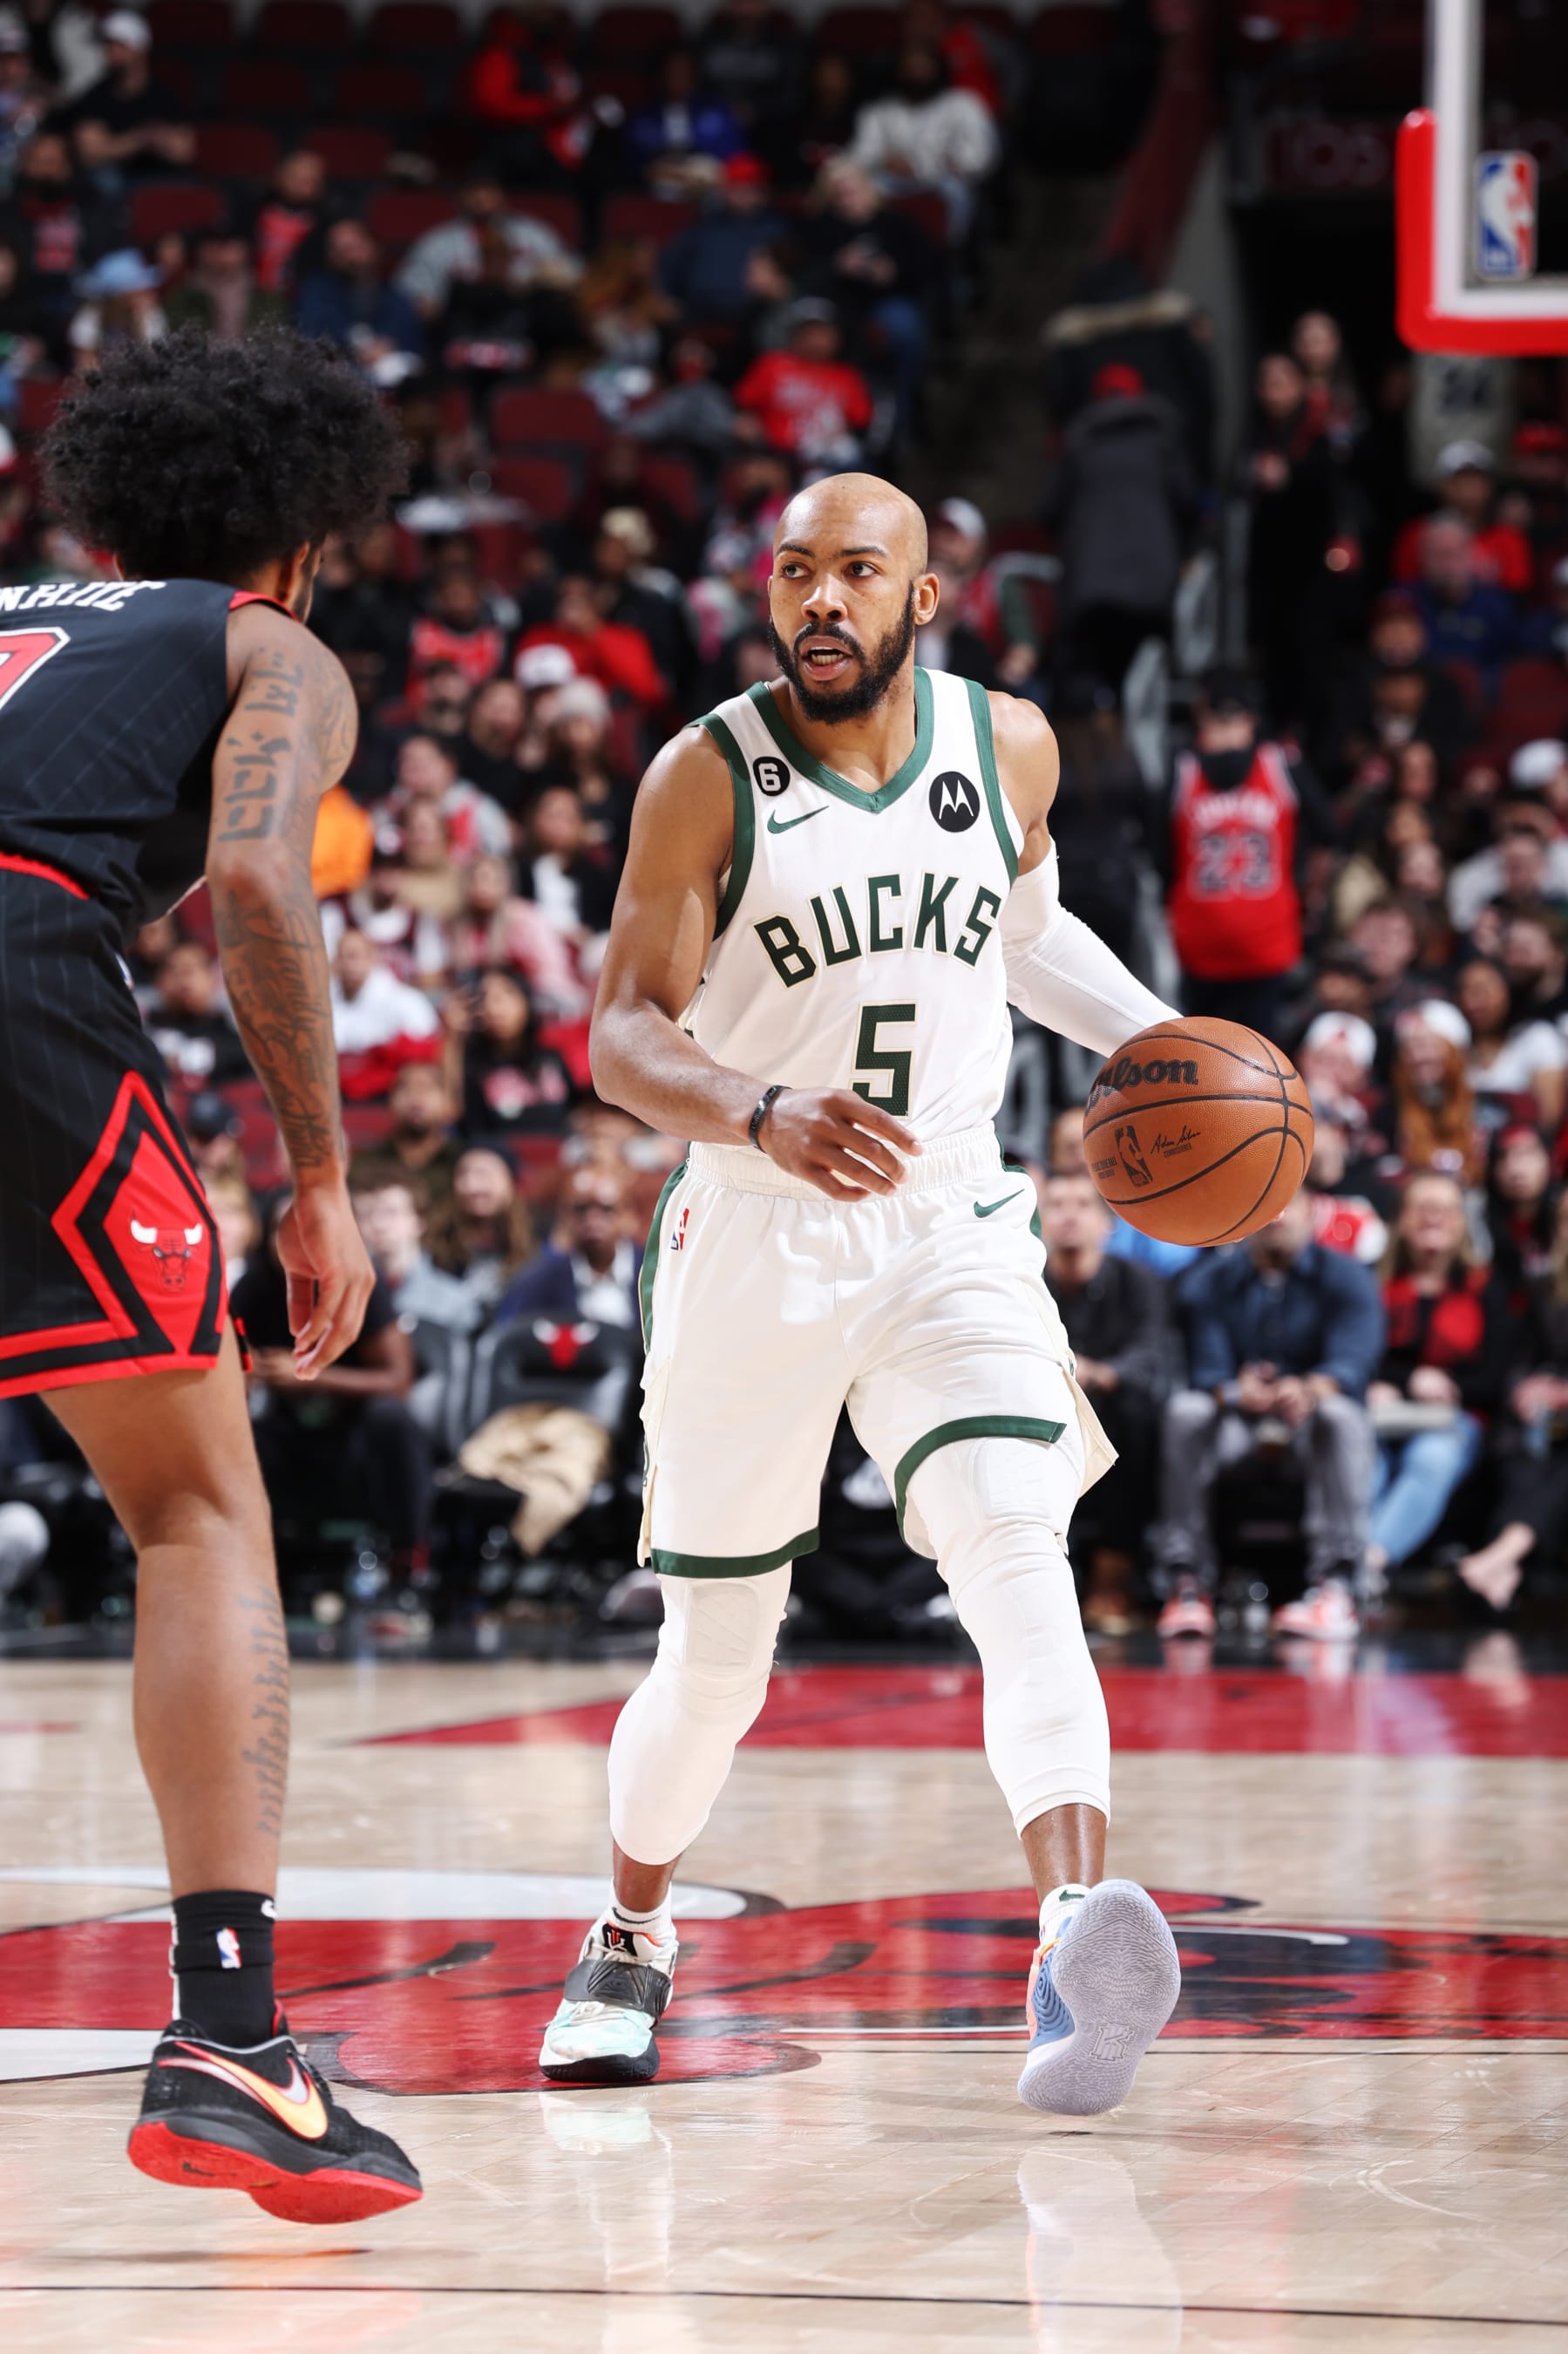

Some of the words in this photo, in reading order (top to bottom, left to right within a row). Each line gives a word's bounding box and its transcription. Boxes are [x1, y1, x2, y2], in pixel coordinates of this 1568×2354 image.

[757, 761, 784, 794] 6
[751, 869, 1003, 990] BUCKS
[850, 1000, 920, 1120] 5
